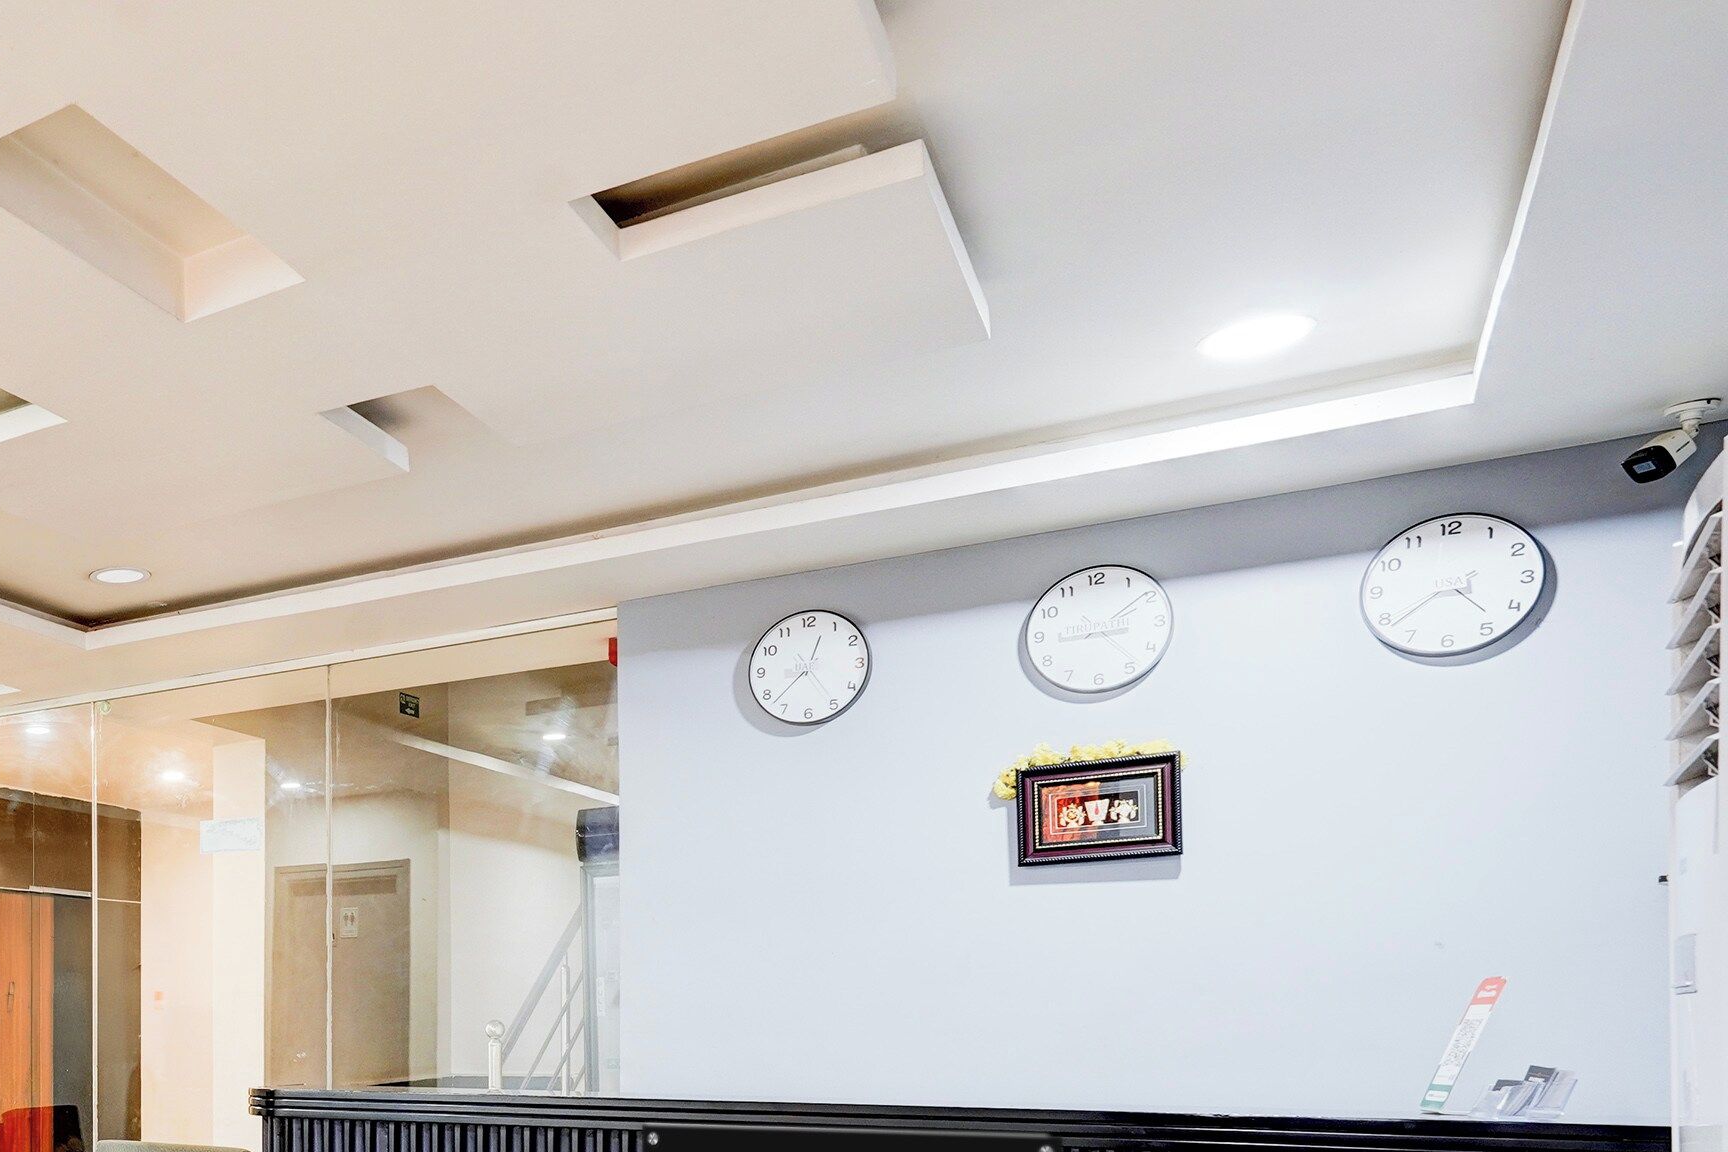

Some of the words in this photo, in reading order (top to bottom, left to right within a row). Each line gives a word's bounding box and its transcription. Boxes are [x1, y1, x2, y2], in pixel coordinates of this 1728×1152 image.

[1440, 520, 1462, 536] 12
[1406, 536, 1421, 548] 11
[1511, 543, 1525, 556] 2
[1380, 557, 1401, 572] 10
[1088, 572, 1105, 586] 12
[1521, 570, 1534, 583] 3
[1060, 586, 1073, 597] 11
[1370, 586, 1383, 599] 9
[1508, 599, 1520, 611] 4
[1041, 606, 1058, 619] 10
[802, 616, 816, 628] 12
[1154, 615, 1165, 627] 3
[1378, 613, 1391, 626] 8
[779, 627, 790, 638] 11
[1480, 622, 1493, 636] 5
[849, 635, 858, 646] 2
[1033, 632, 1044, 643] 9
[1405, 629, 1417, 643] 7
[1441, 634, 1454, 648] 6
[764, 645, 777, 656] 10
[1146, 642, 1156, 652] 4
[855, 657, 864, 668] 3
[1042, 655, 1052, 666] 8
[757, 667, 765, 678] 9
[1124, 661, 1137, 674] 5
[1064, 670, 1073, 682] 7
[1094, 673, 1104, 685] 6
[848, 681, 856, 691] 4
[763, 689, 771, 700] 8
[780, 704, 788, 715] 7
[830, 699, 838, 710] 5
[804, 708, 813, 719] 6
